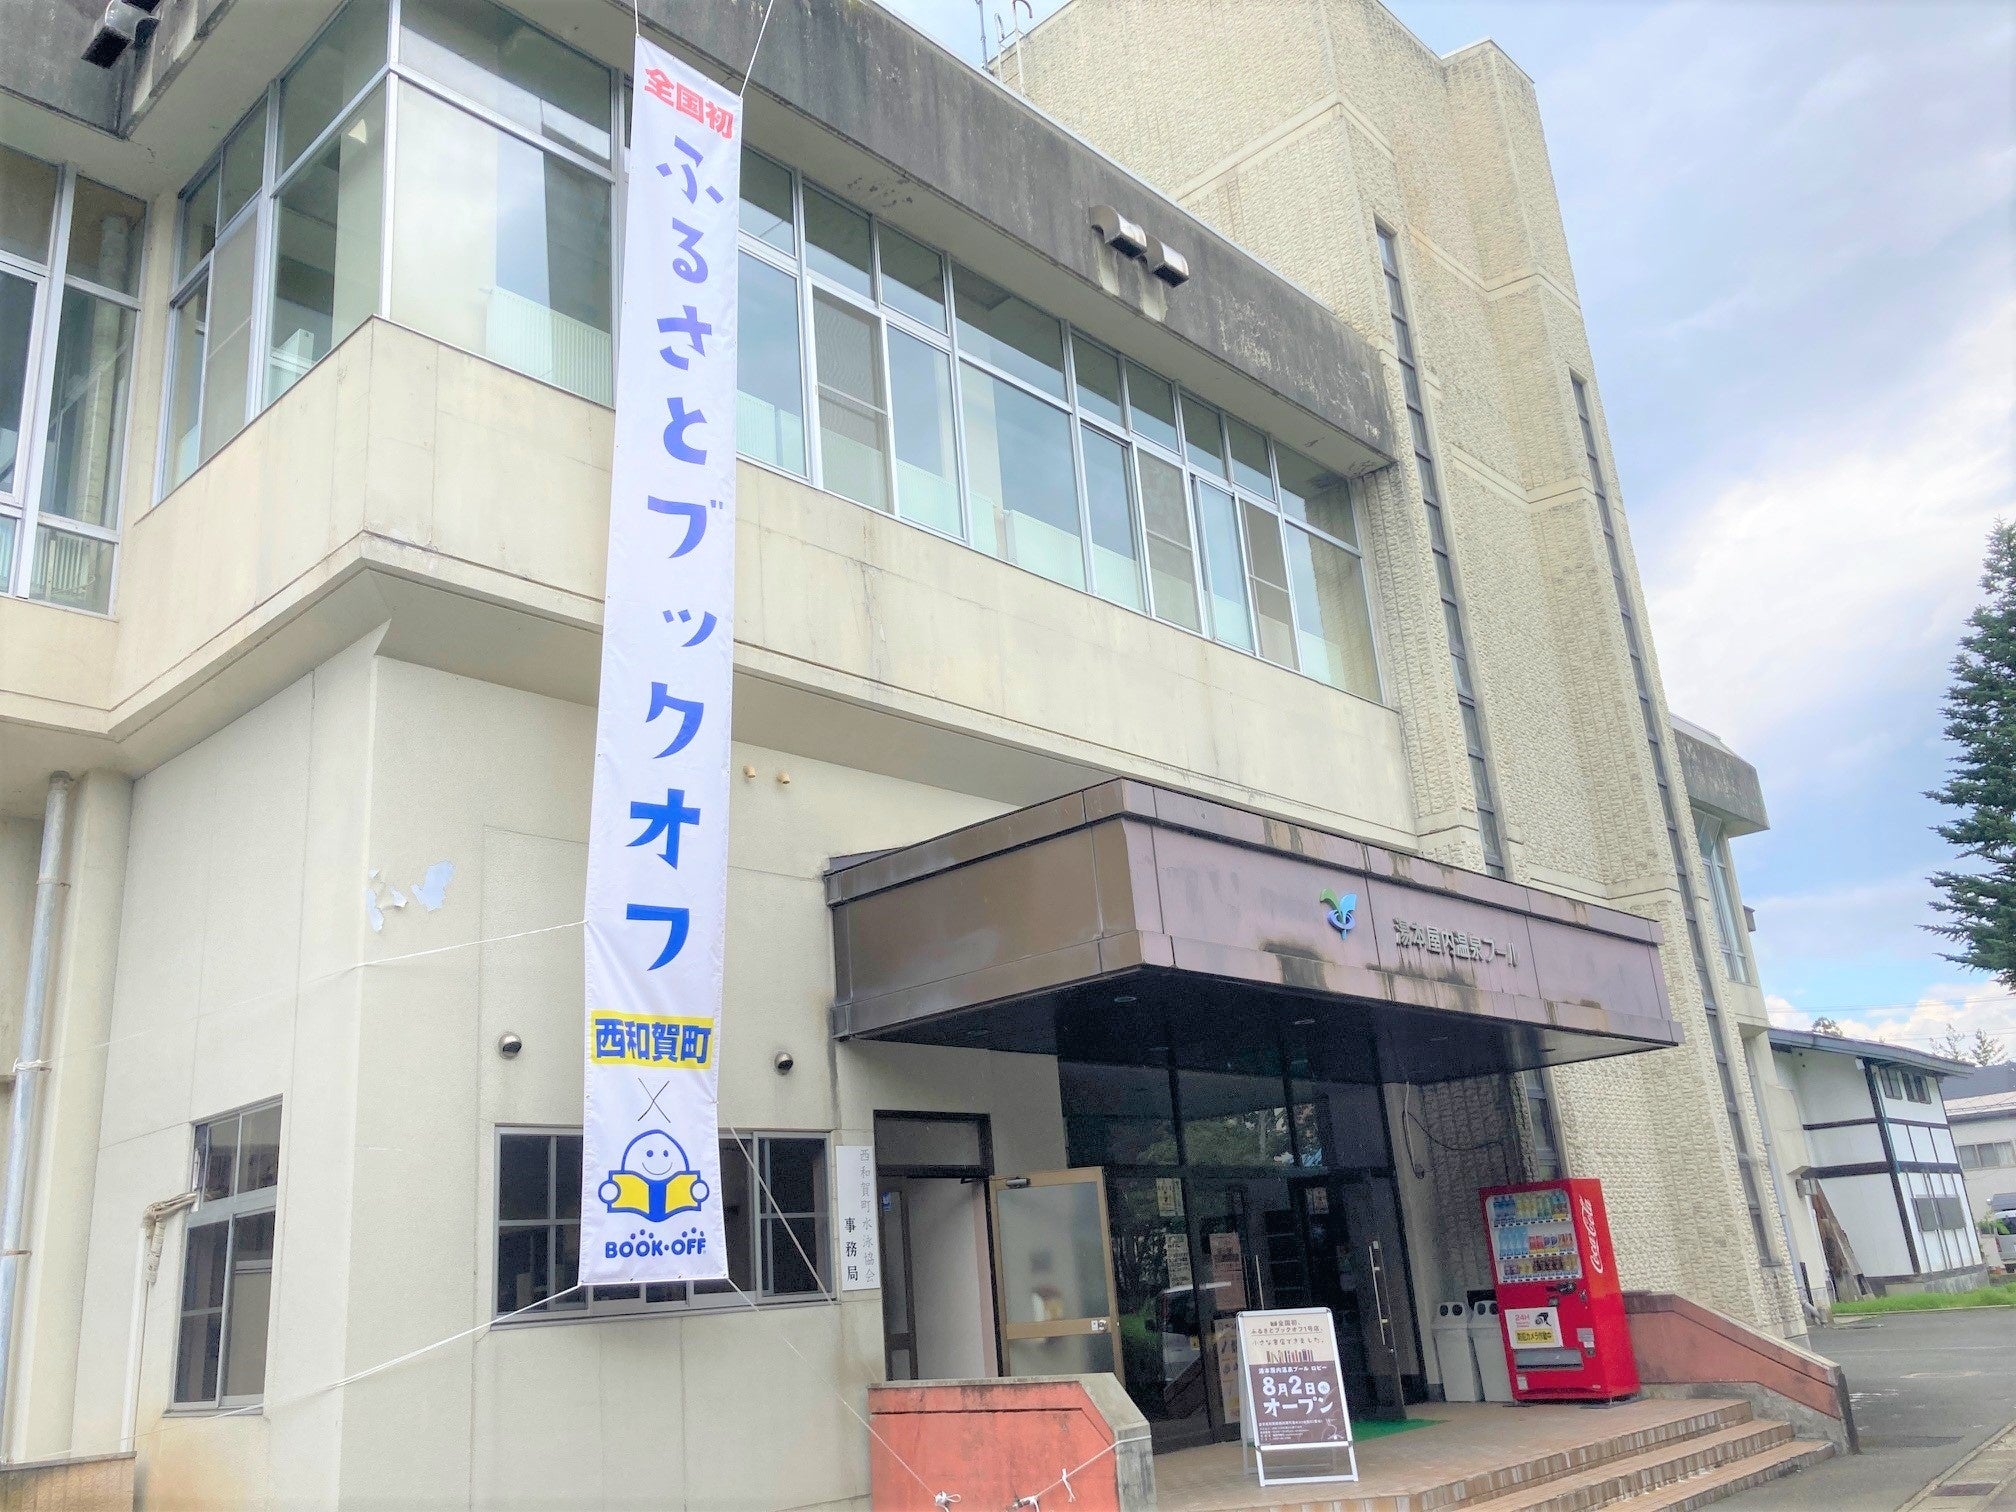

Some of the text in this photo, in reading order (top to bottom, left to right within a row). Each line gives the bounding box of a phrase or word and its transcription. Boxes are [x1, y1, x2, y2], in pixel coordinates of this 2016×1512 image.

[644, 66, 734, 140] 全国初
[625, 135, 725, 973] ふるさとブックオフ
[1392, 915, 1520, 968] 湯本屋内温泉プール
[594, 1018, 712, 1064] 西和賀町
[844, 1217, 859, 1282] 事務局
[1263, 1396, 1333, 1418] オープン
